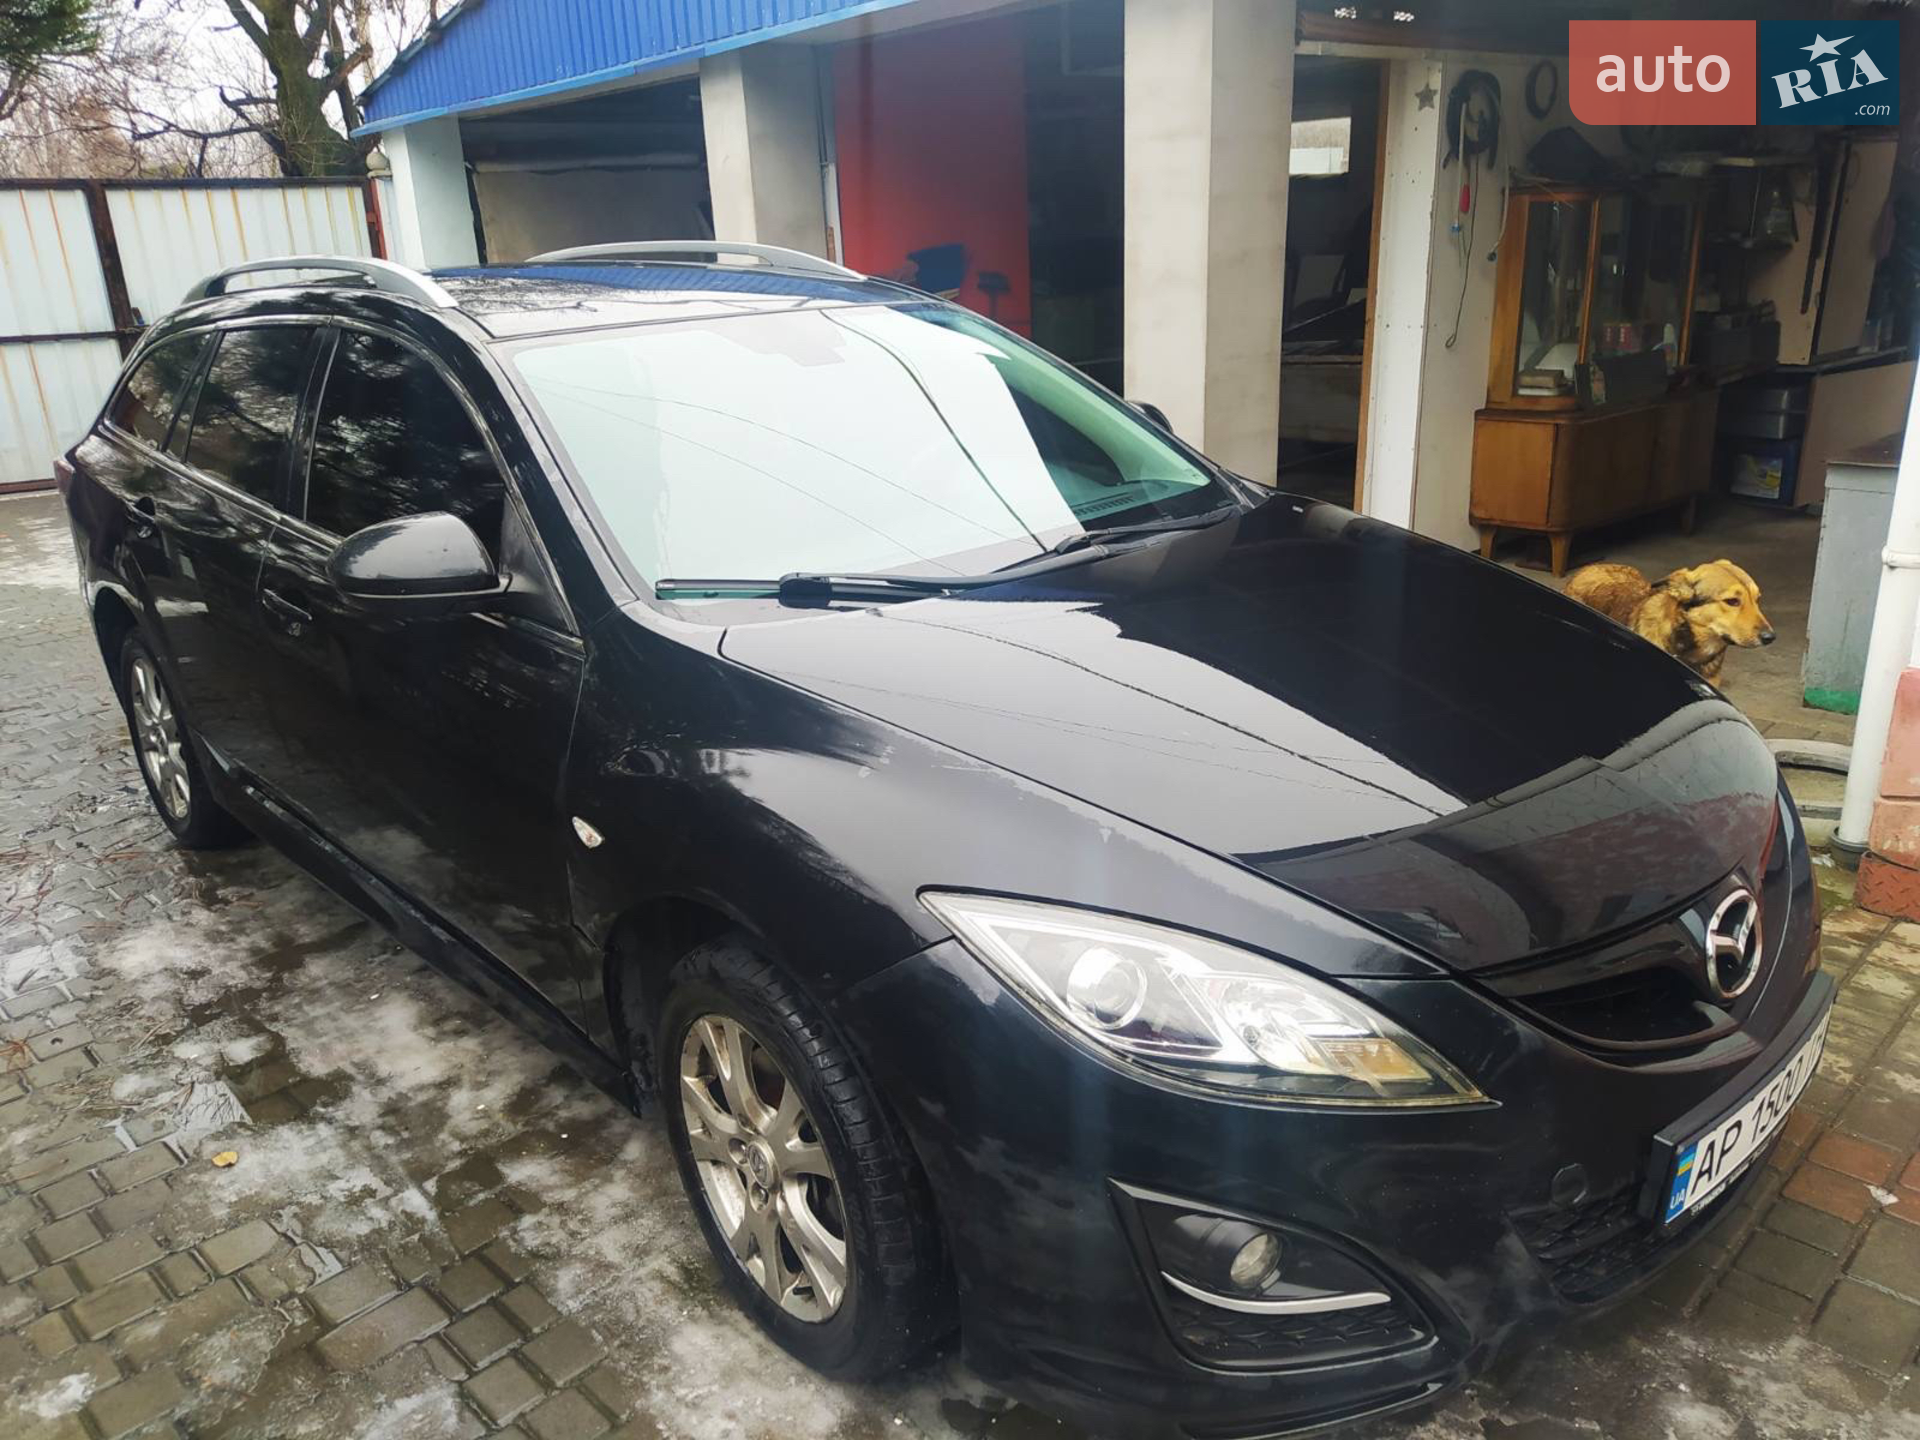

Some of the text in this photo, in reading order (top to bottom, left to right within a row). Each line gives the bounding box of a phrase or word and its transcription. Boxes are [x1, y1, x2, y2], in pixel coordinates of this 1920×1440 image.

[1690, 1119, 1743, 1197] AP
[1751, 1054, 1804, 1143] 1500
[1670, 1188, 1686, 1211] UA
